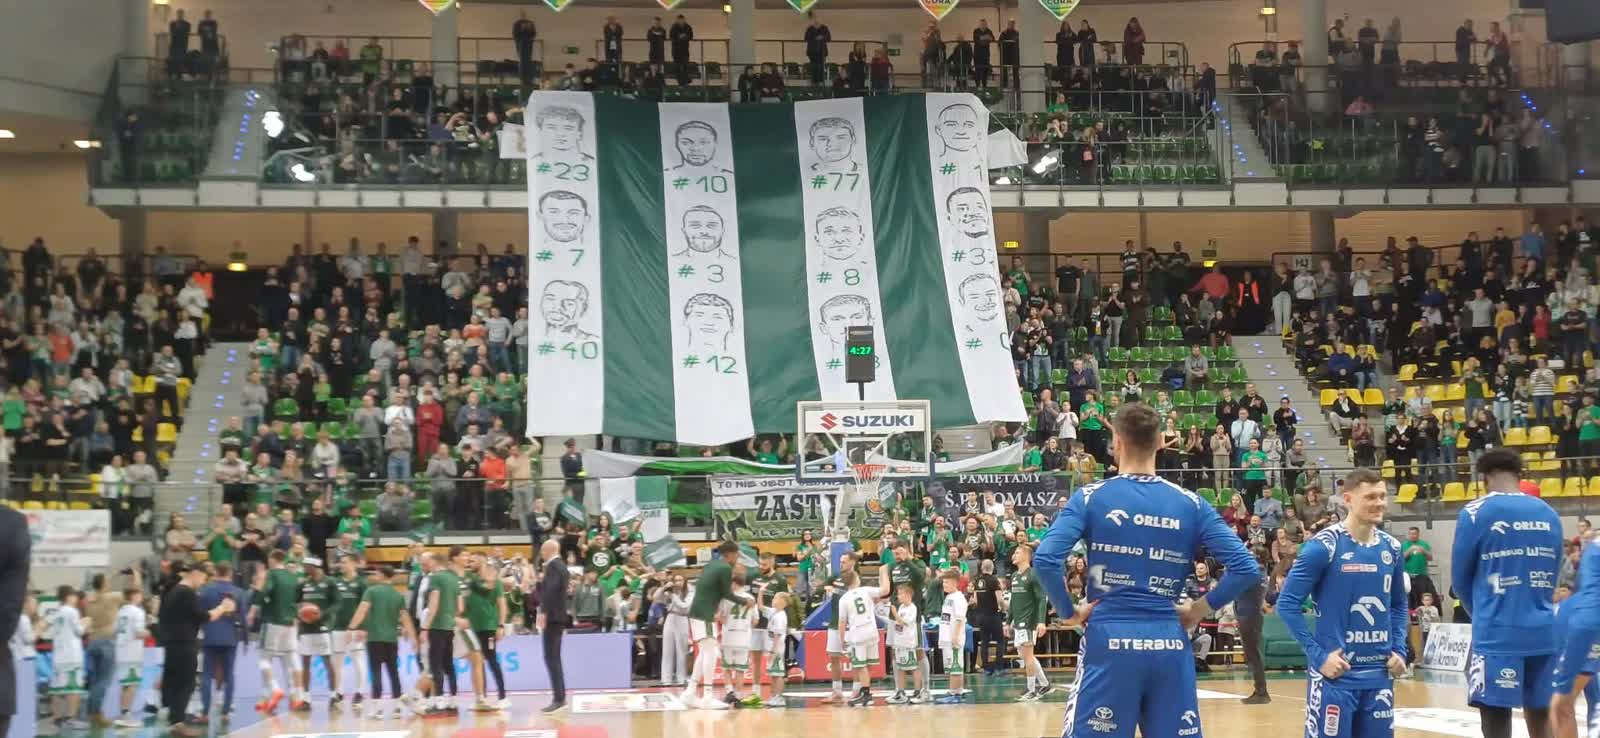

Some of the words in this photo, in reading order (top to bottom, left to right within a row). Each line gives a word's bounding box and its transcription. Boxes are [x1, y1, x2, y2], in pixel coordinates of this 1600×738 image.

[536, 162, 590, 181] #23
[811, 172, 860, 192] #77
[537, 341, 598, 360] #40
[850, 346, 872, 355] 4:27
[842, 415, 915, 427] SUZUKI
[959, 473, 1041, 486] PAMIĘTAMY
[1133, 514, 1180, 530] ORLEN
[1512, 521, 1550, 531] ORLEN
[855, 597, 867, 615] 6
